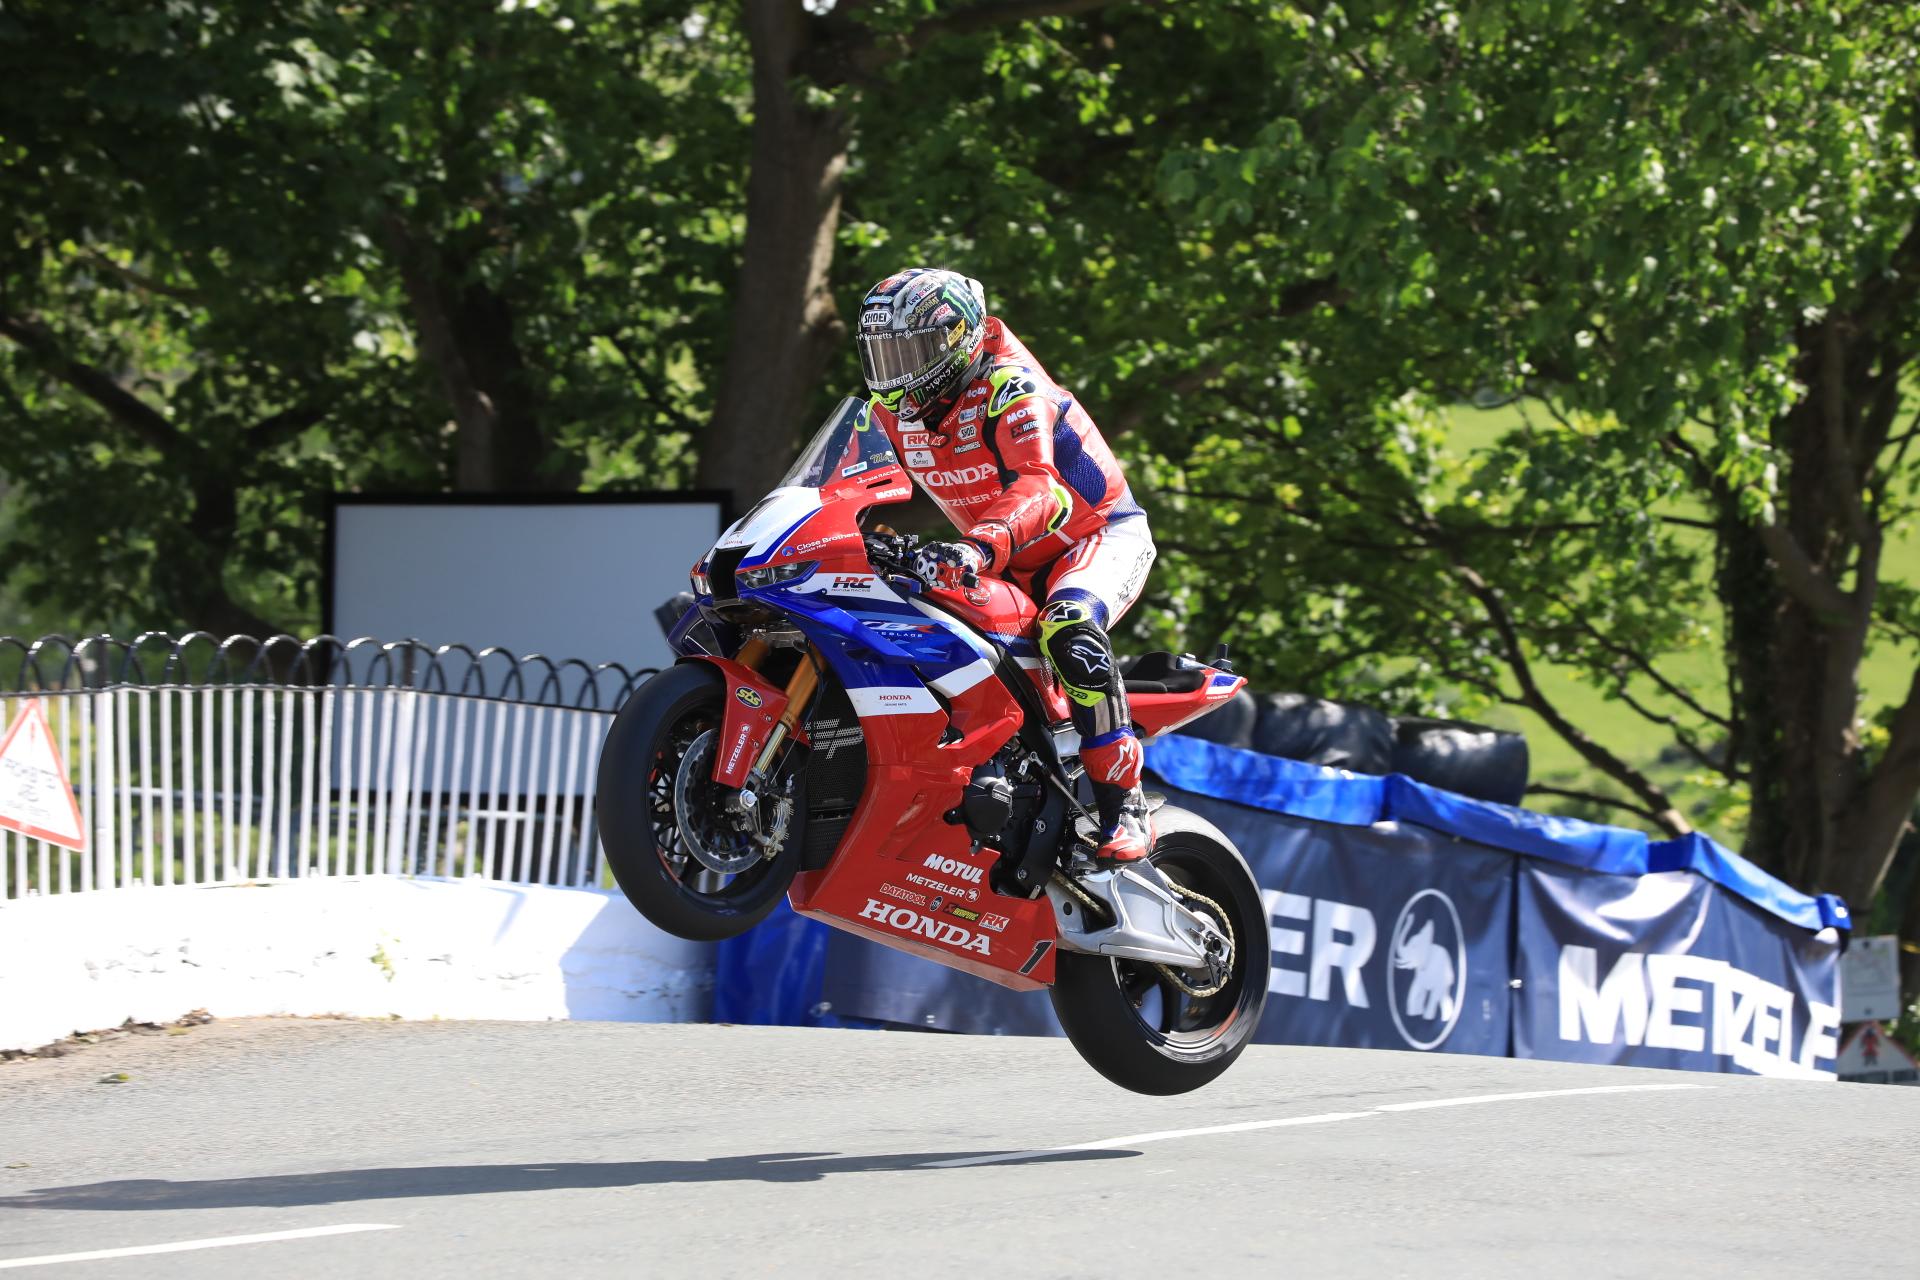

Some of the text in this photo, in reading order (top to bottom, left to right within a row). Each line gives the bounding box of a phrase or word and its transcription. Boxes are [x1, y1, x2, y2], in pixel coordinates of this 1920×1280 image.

[864, 312, 888, 324] SHOEI
[935, 304, 951, 319] NGK
[864, 332, 893, 341] Bennetts
[925, 352, 965, 392] MONSTER
[1006, 409, 1032, 425] MOT
[907, 434, 928, 445] RK
[875, 488, 910, 499] MOTUL
[797, 532, 860, 551] Close Brothers
[832, 576, 874, 588] HRC
[725, 733, 747, 775] METZELER
[923, 853, 985, 884] MOTUL
[905, 873, 966, 898] METZELER
[880, 882, 927, 907] DATATOOL
[858, 898, 993, 956] HONDA
[983, 913, 1006, 929] RK
[1017, 939, 1055, 976] 1
